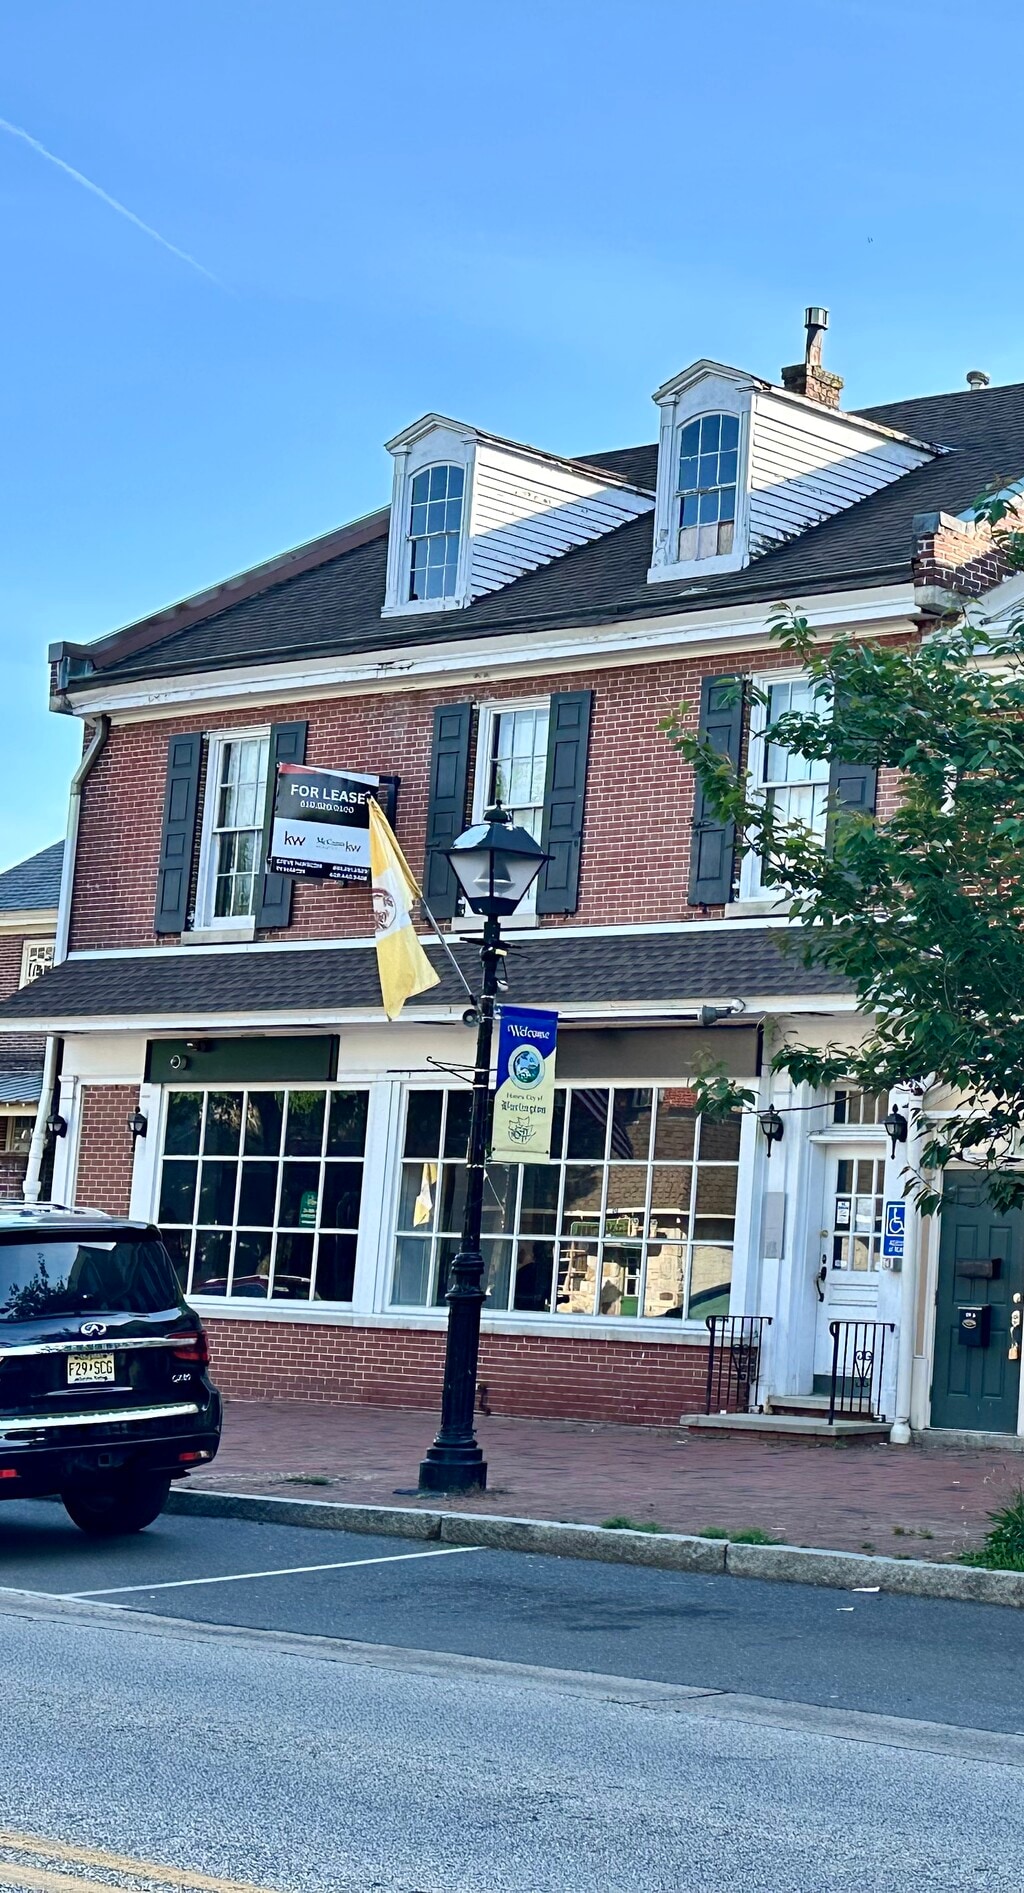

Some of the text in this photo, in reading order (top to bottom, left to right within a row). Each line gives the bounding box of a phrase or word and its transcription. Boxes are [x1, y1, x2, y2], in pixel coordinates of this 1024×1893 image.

[290, 783, 366, 805] FOR LEASE
[508, 1024, 550, 1039] Welcome
